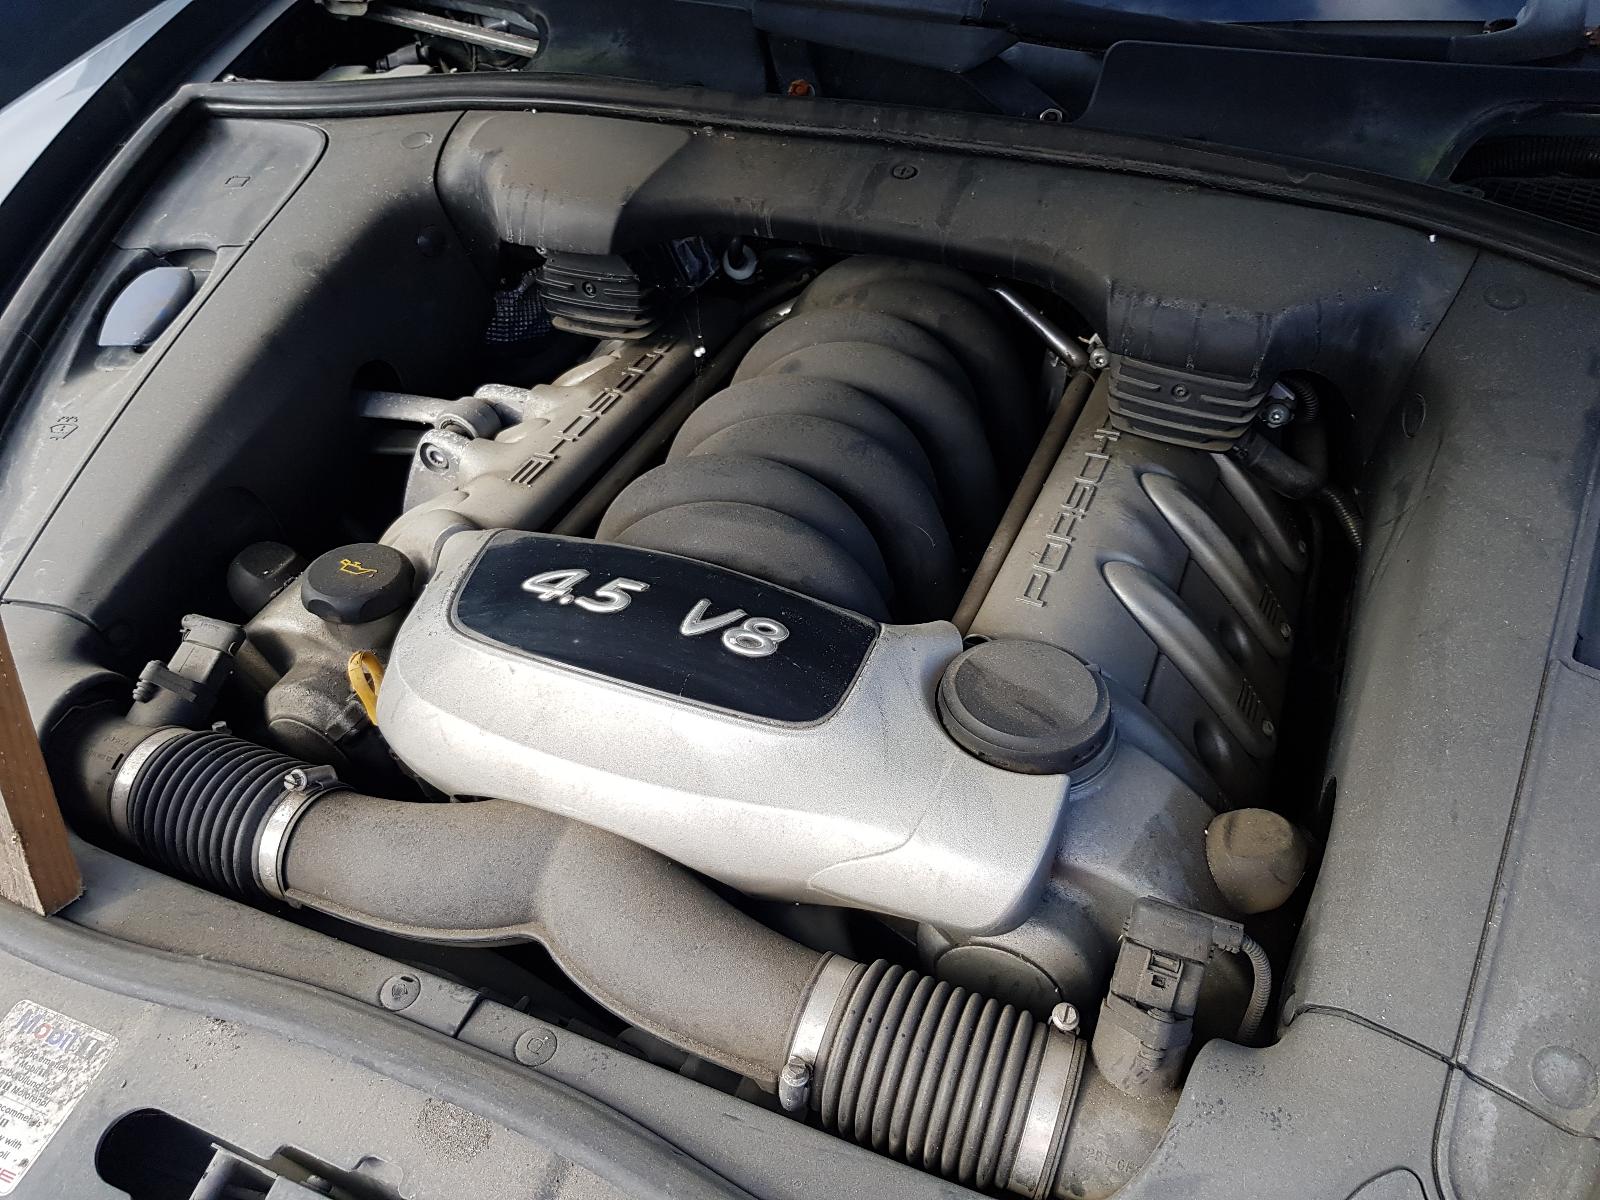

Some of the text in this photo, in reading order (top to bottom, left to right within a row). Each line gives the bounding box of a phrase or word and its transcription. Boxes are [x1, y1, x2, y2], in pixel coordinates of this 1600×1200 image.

[507, 335, 681, 488] PORSCHE
[521, 568, 790, 657] 4.5 V8
[10, 1008, 81, 1053] Mobil
[5, 1136, 22, 1150] with
